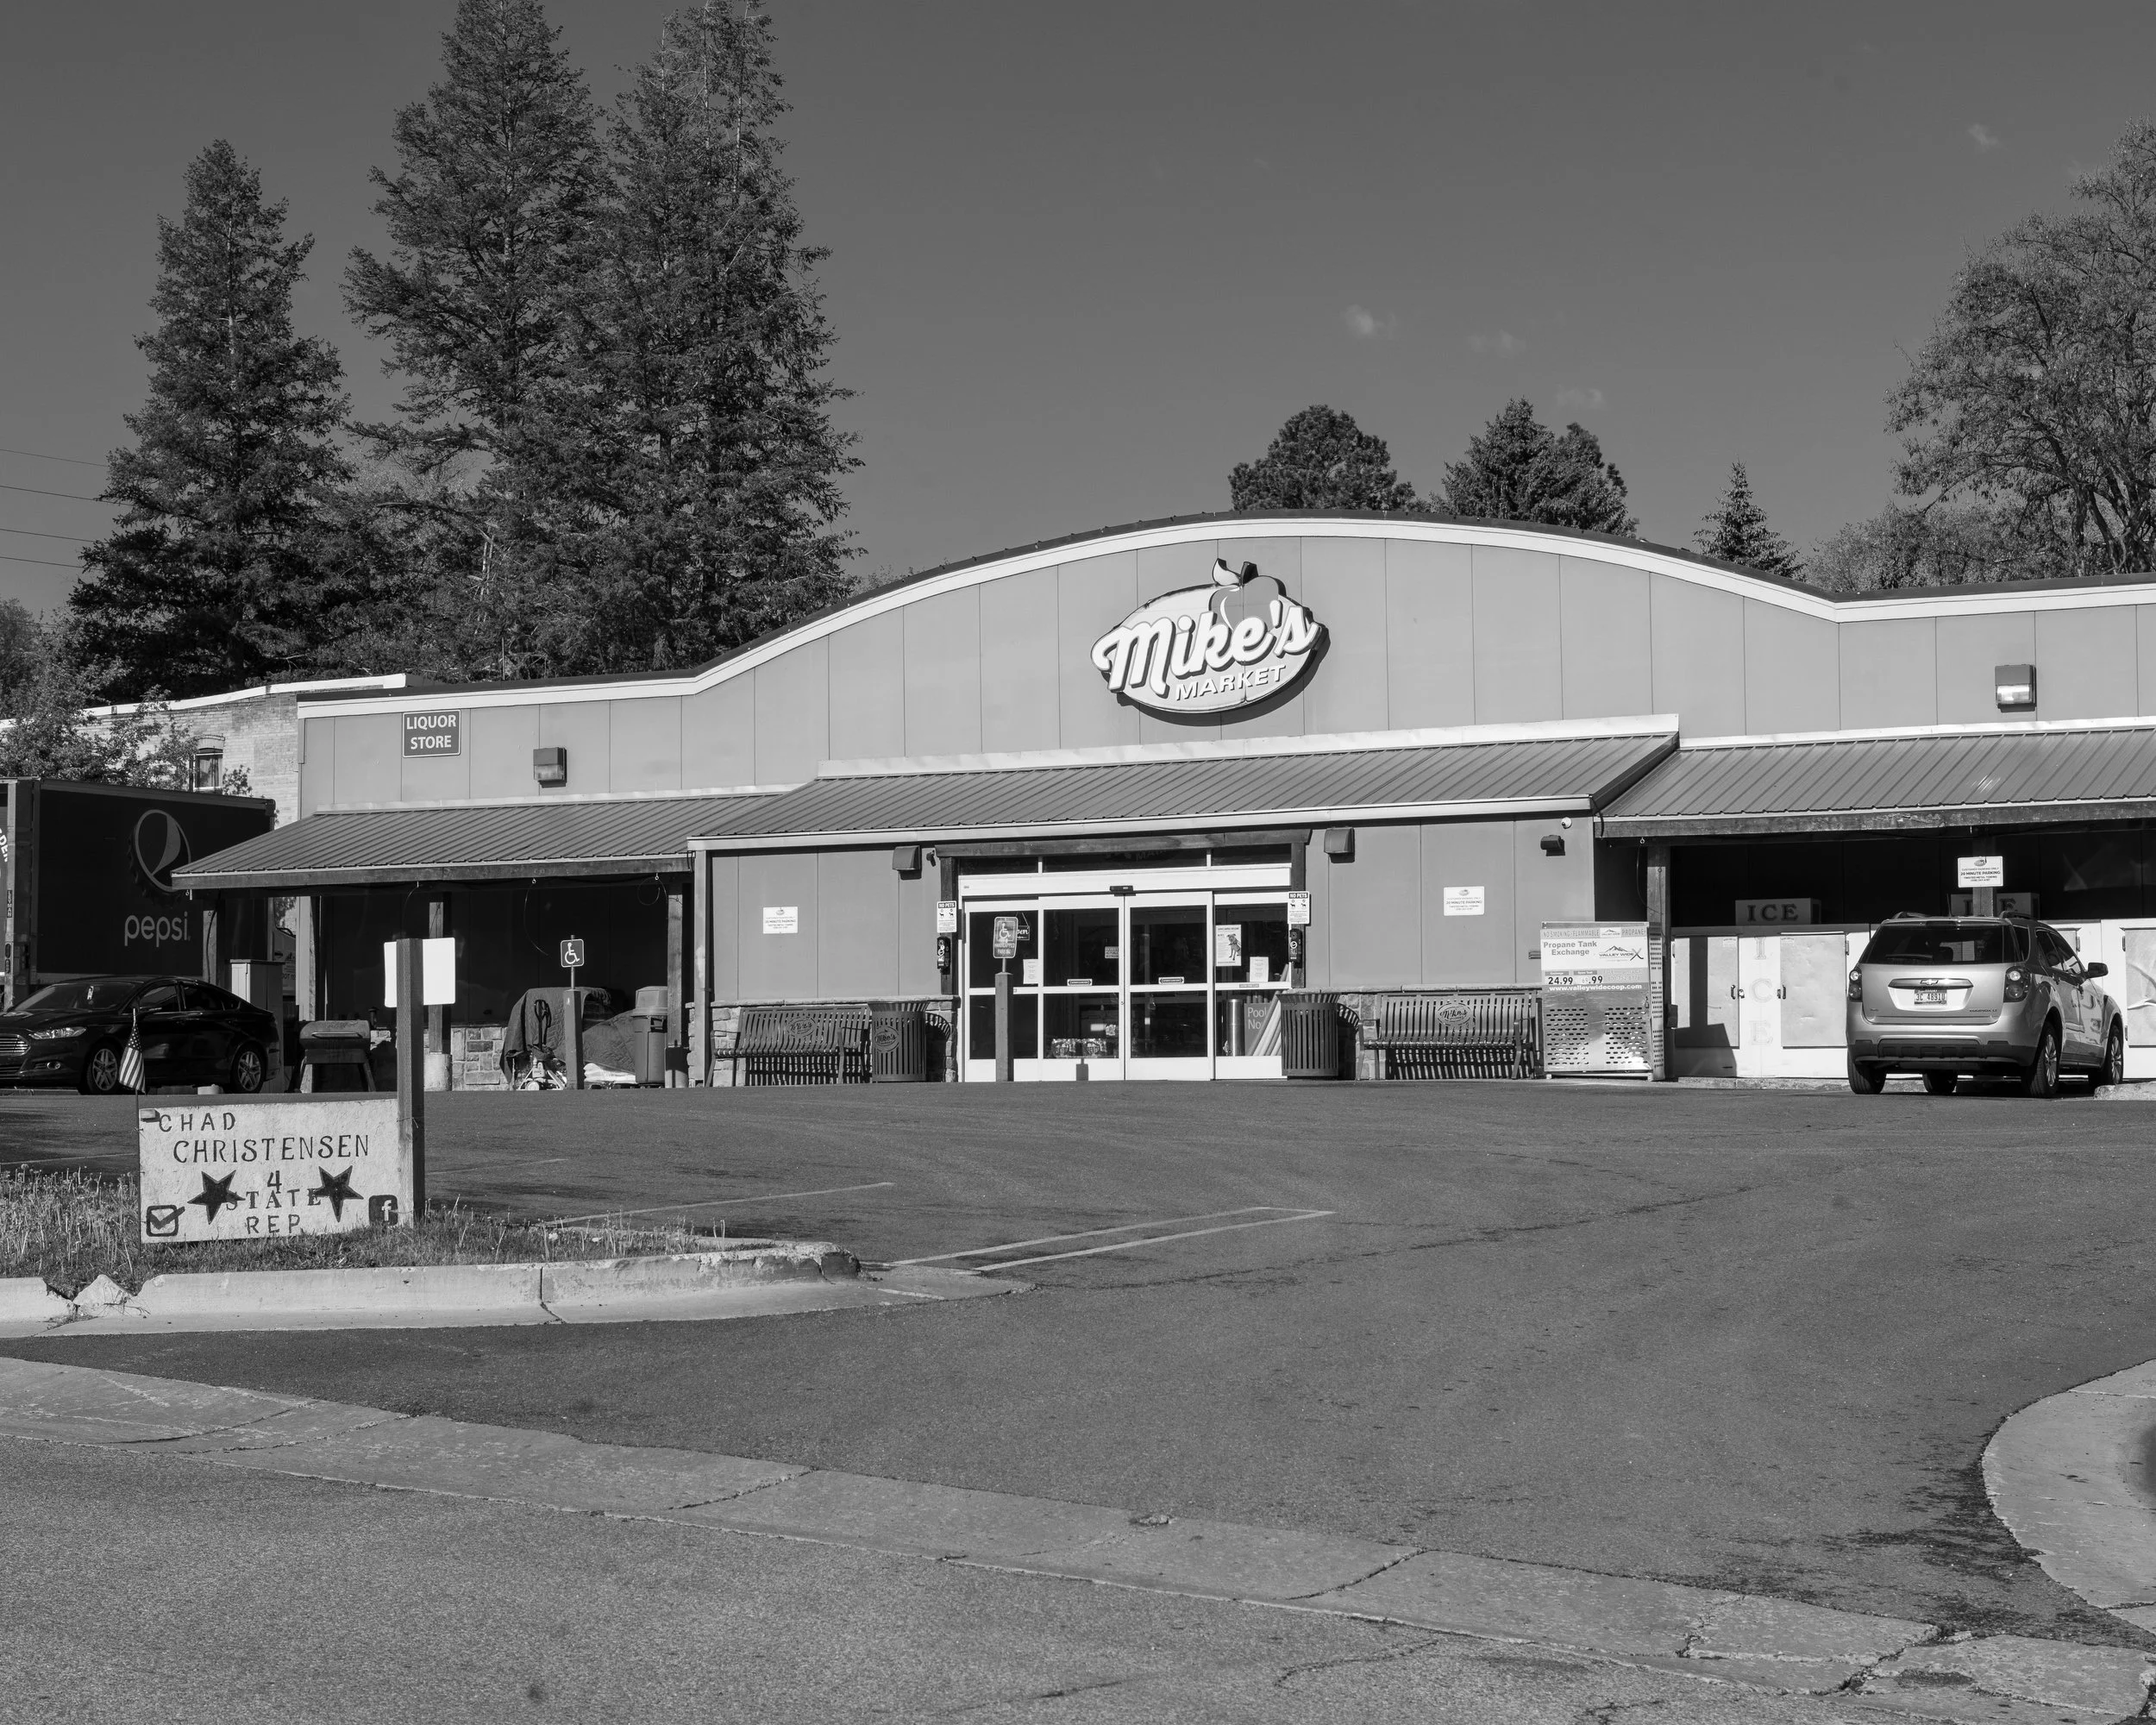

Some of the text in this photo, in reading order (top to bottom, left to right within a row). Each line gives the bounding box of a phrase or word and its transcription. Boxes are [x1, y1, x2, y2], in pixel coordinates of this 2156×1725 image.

[1090, 600, 1322, 697] Mike's
[1175, 664, 1286, 701] MARKET
[406, 714, 456, 730] LIQUOR
[411, 735, 452, 750] STORE
[1747, 904, 1798, 921] ICE
[1964, 899, 2016, 916] IE
[124, 911, 188, 947] pepsi
[1548, 976, 1573, 985] 24.99
[1248, 1007, 1267, 1018] Pool
[1248, 1019, 1262, 1030] No
[159, 1113, 236, 1132] CHAD
[173, 1135, 369, 1163] CHRISTENSEN
[266, 1170, 282, 1194] 4
[226, 1188, 322, 1211] STATE
[247, 1214, 300, 1234] REP
